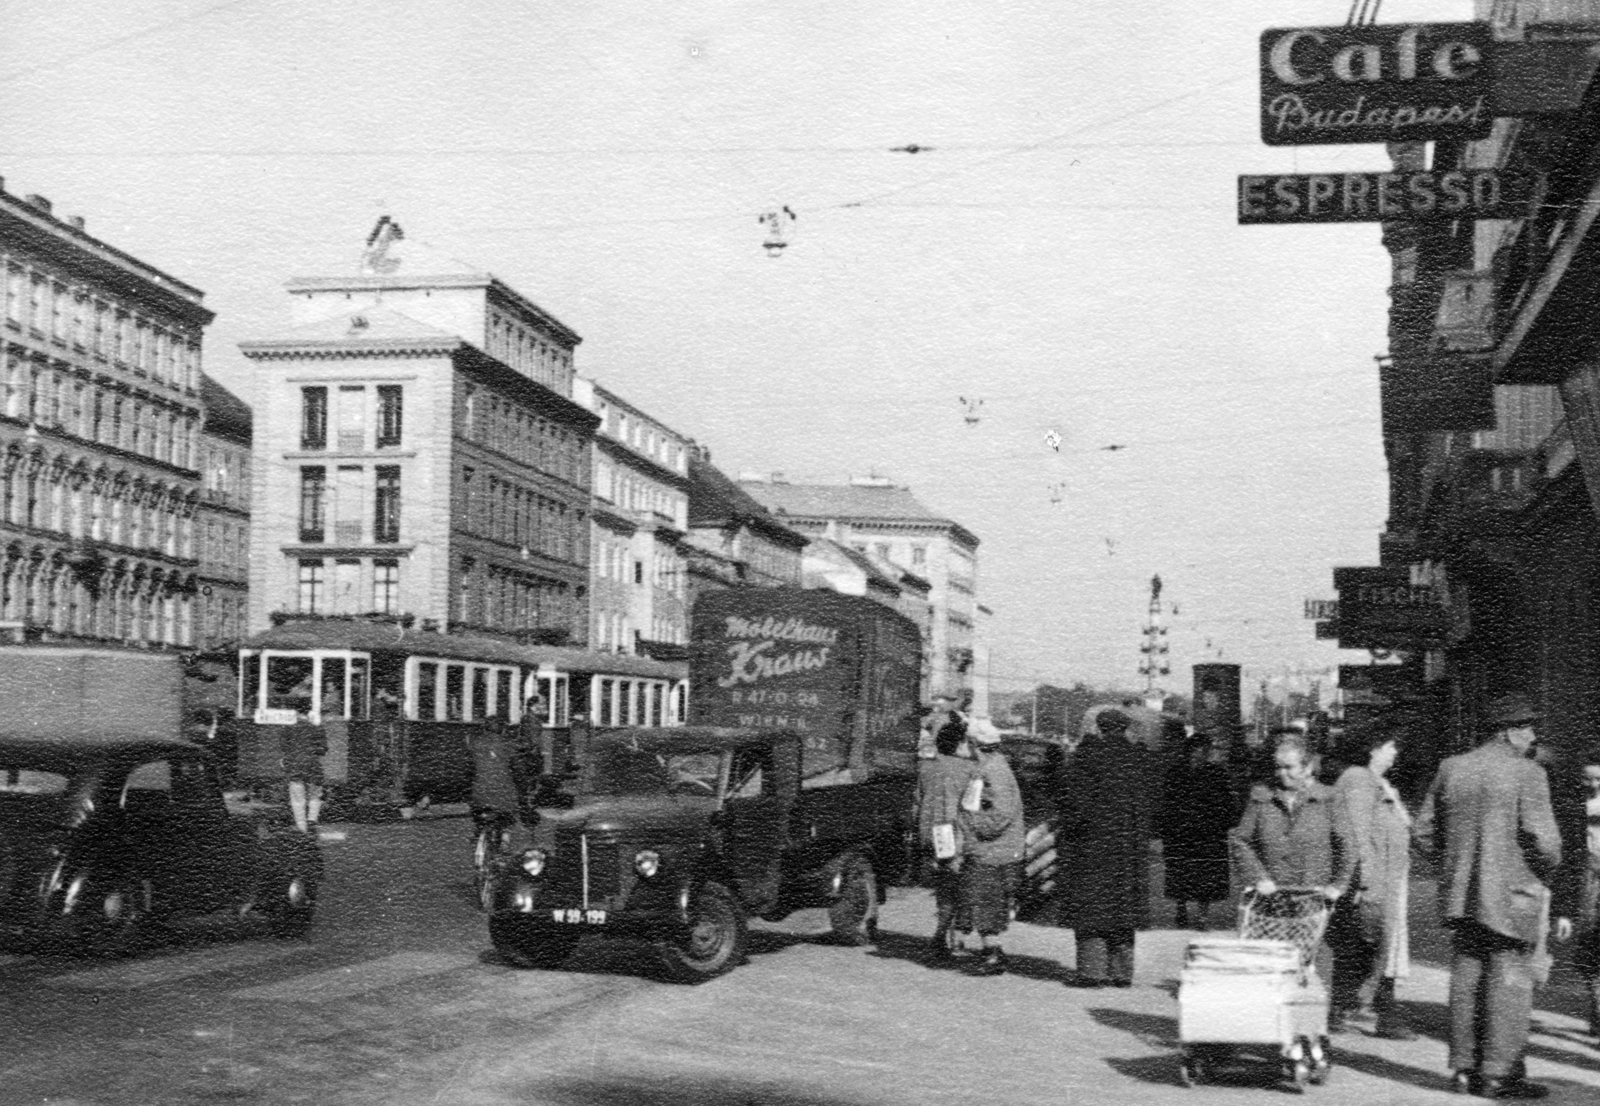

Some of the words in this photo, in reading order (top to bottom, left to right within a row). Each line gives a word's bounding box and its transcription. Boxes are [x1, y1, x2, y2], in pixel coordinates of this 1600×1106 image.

[1268, 92, 1484, 133] Budapest
[1240, 172, 1500, 216] ESPRESSO
[553, 909, 565, 923] W
